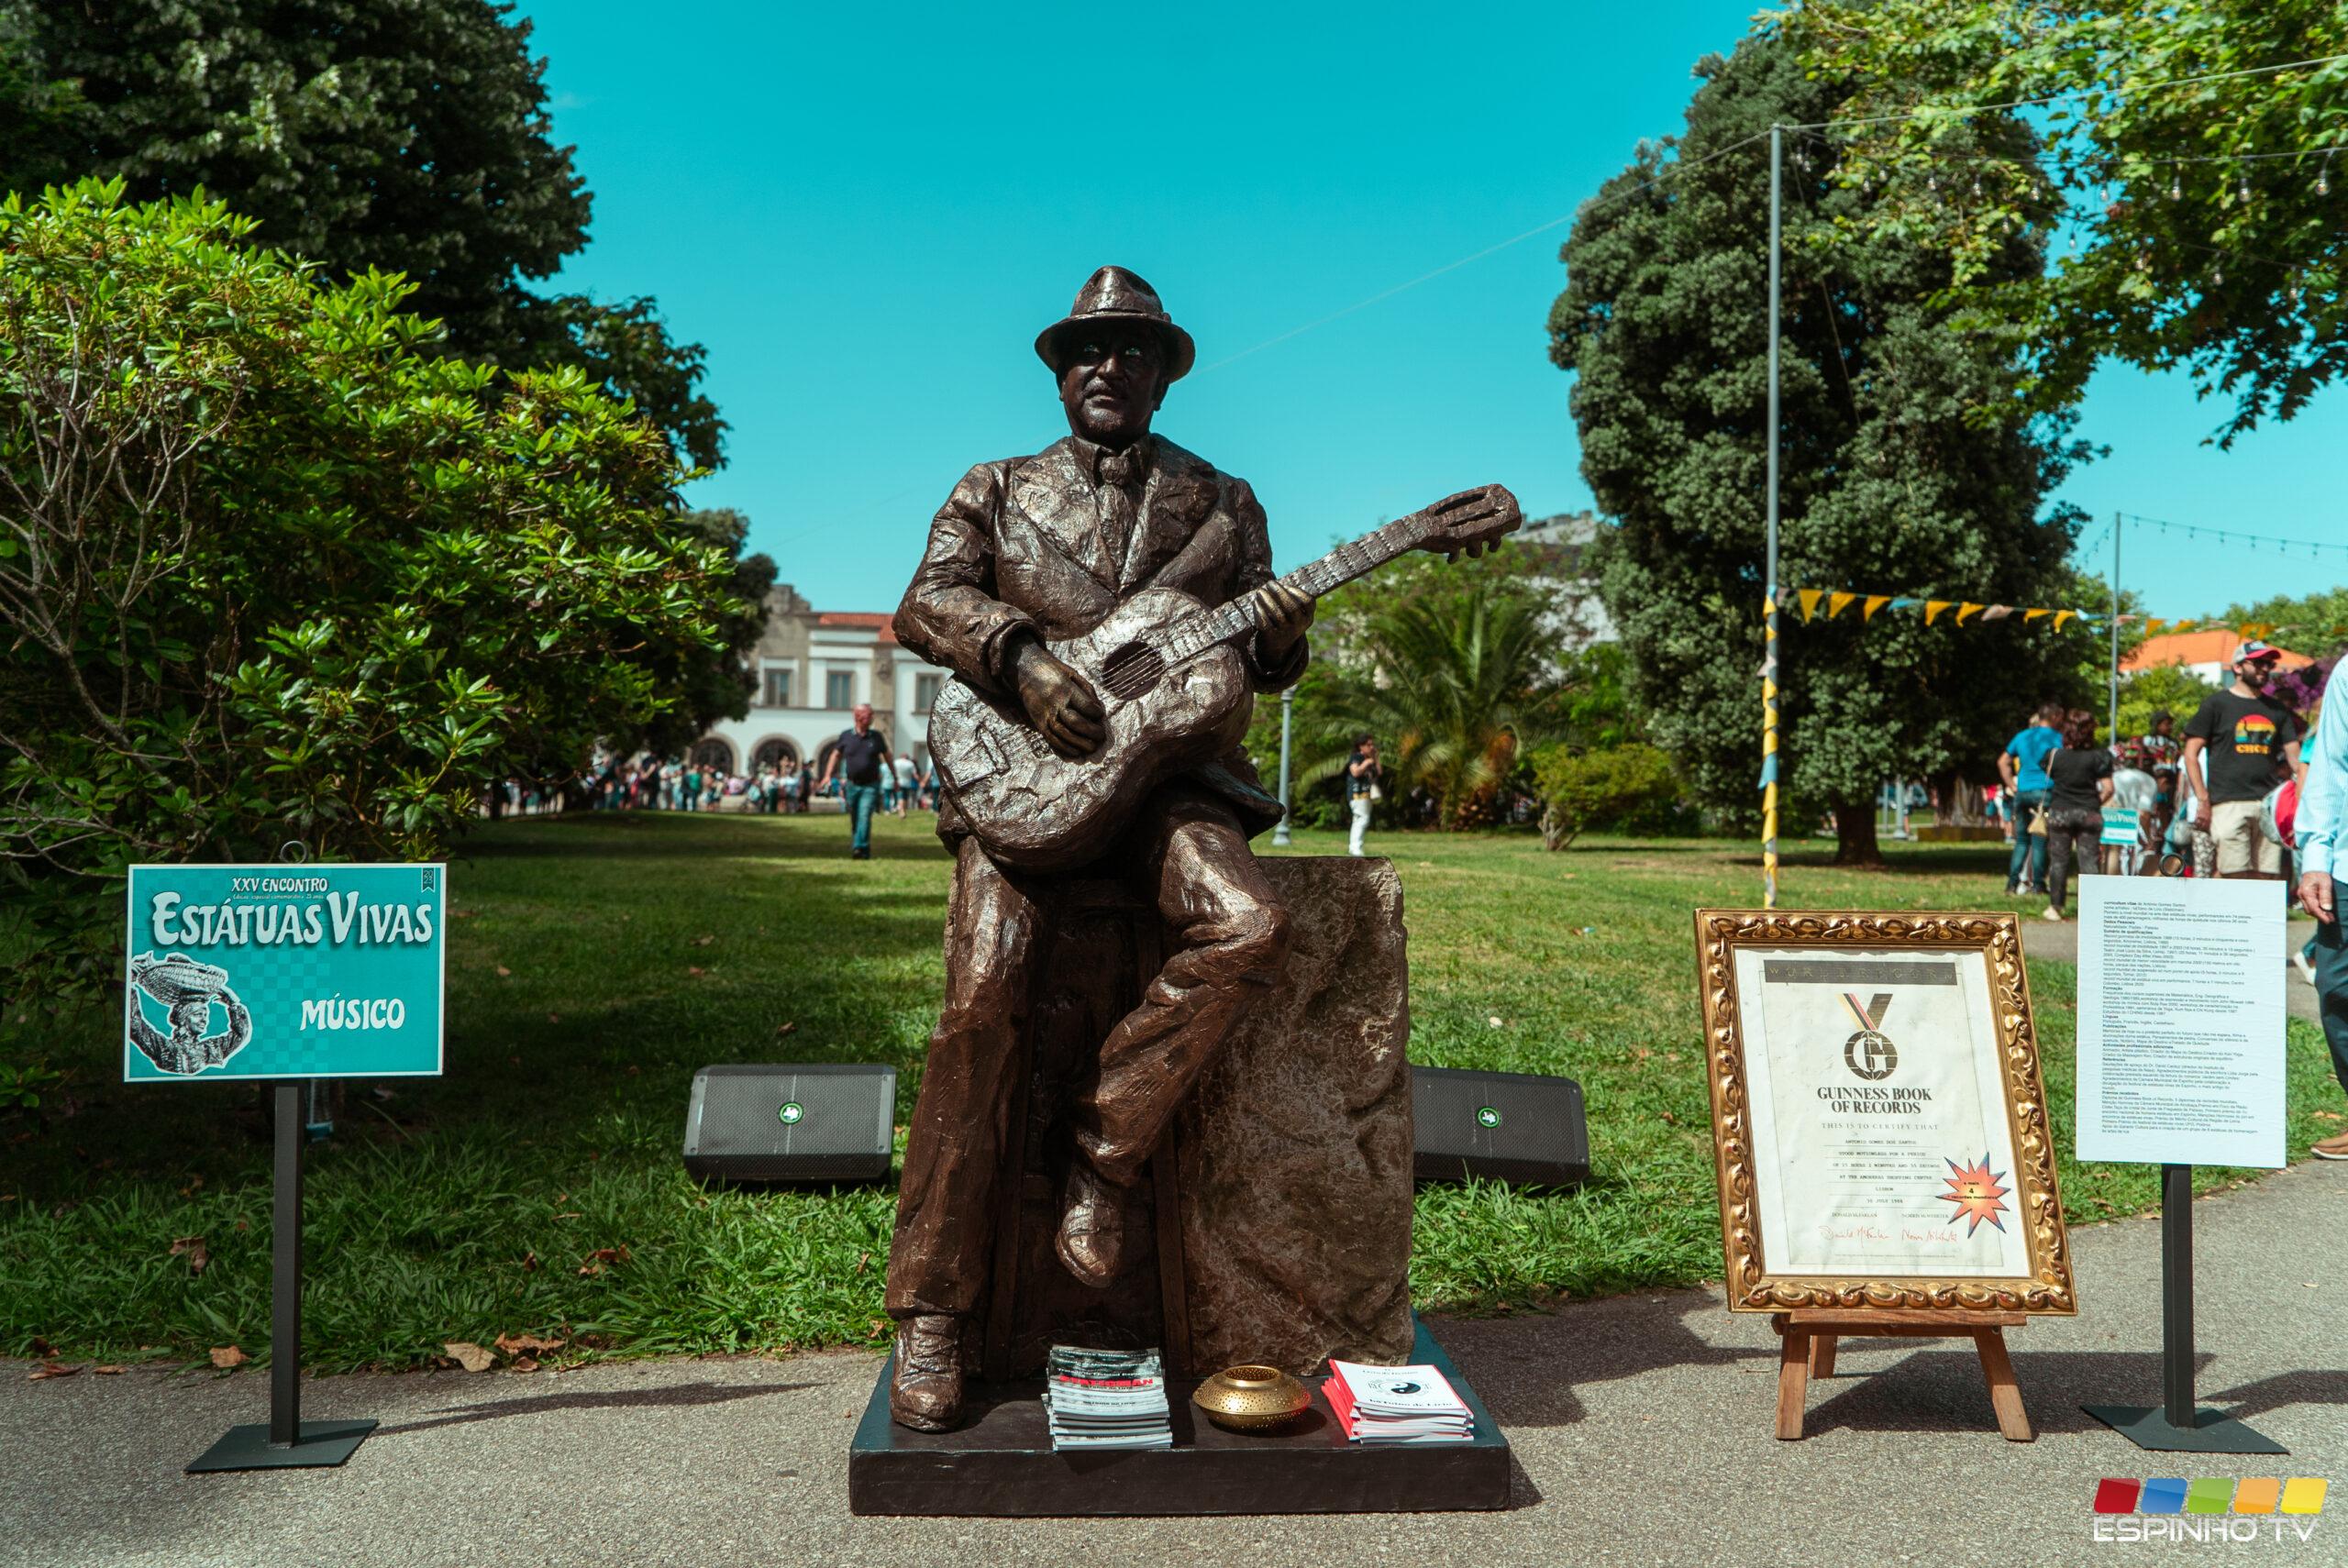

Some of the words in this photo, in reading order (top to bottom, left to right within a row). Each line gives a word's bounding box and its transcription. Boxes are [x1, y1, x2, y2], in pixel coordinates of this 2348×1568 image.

[231, 878, 260, 891] XXV
[262, 878, 328, 892] ENCONTRO
[152, 891, 323, 944] ESTÁTUAS
[327, 890, 433, 944] VIVAS
[300, 992, 405, 1031] MÚSICO
[1817, 1087, 1889, 1100] GUINNESS
[1892, 1088, 1933, 1101] BOOK
[1831, 1100, 1851, 1113] OF
[1853, 1101, 1922, 1115] RECORDS
